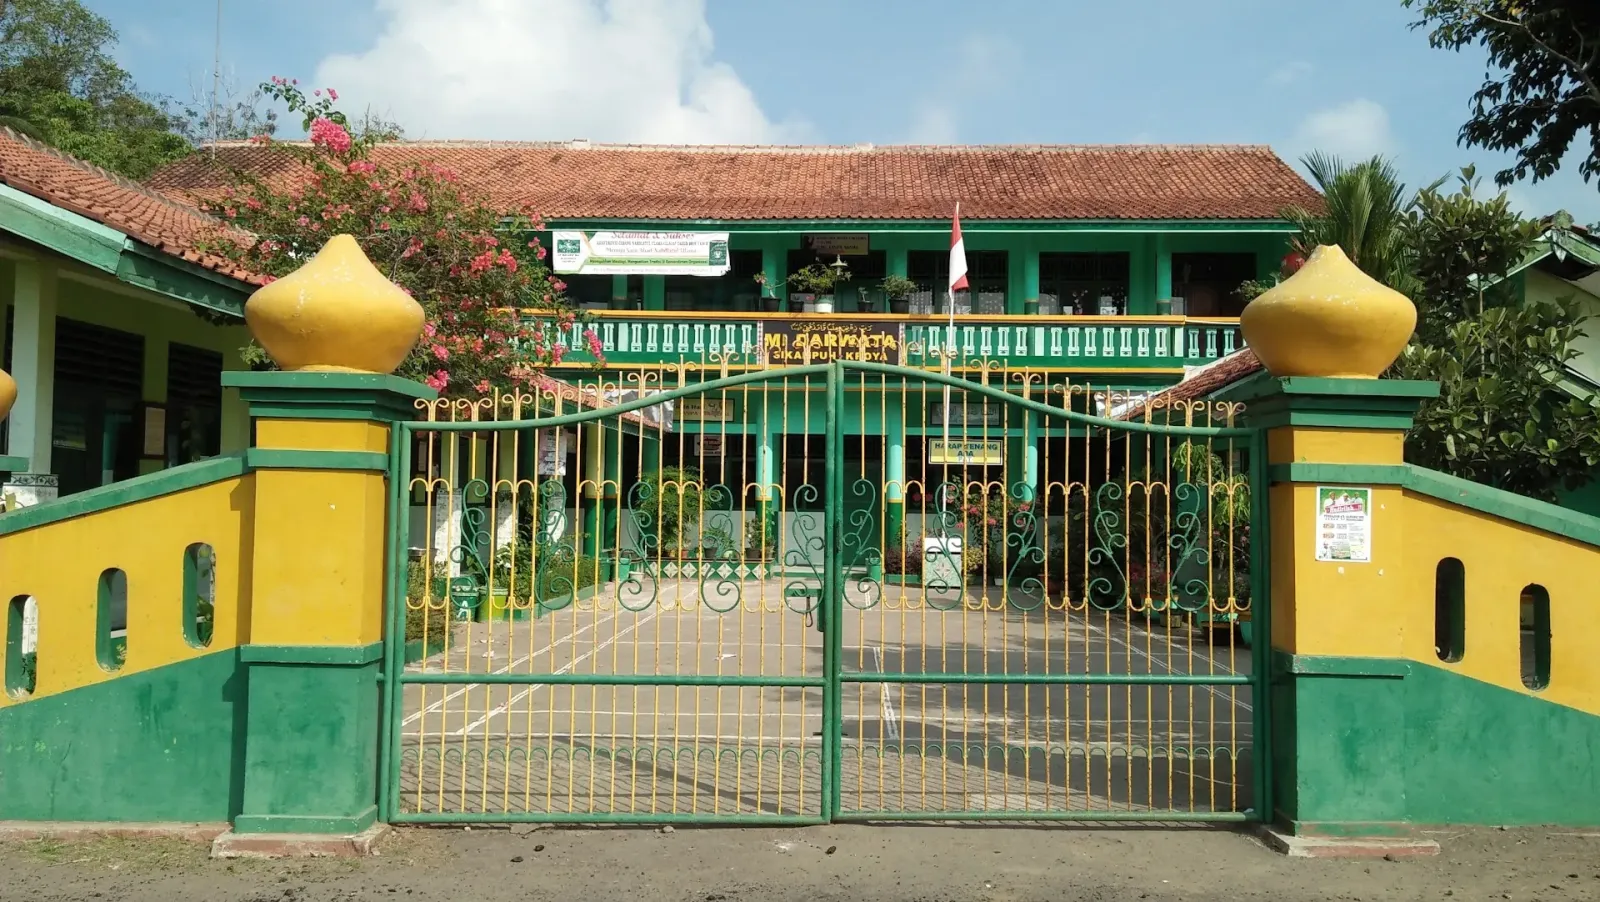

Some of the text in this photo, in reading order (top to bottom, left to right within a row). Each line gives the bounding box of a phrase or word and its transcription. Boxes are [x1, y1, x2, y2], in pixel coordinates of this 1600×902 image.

[663, 231, 695, 240] Sukses
[796, 333, 897, 348] DARWATA
[773, 351, 836, 360] SIKAPUH
